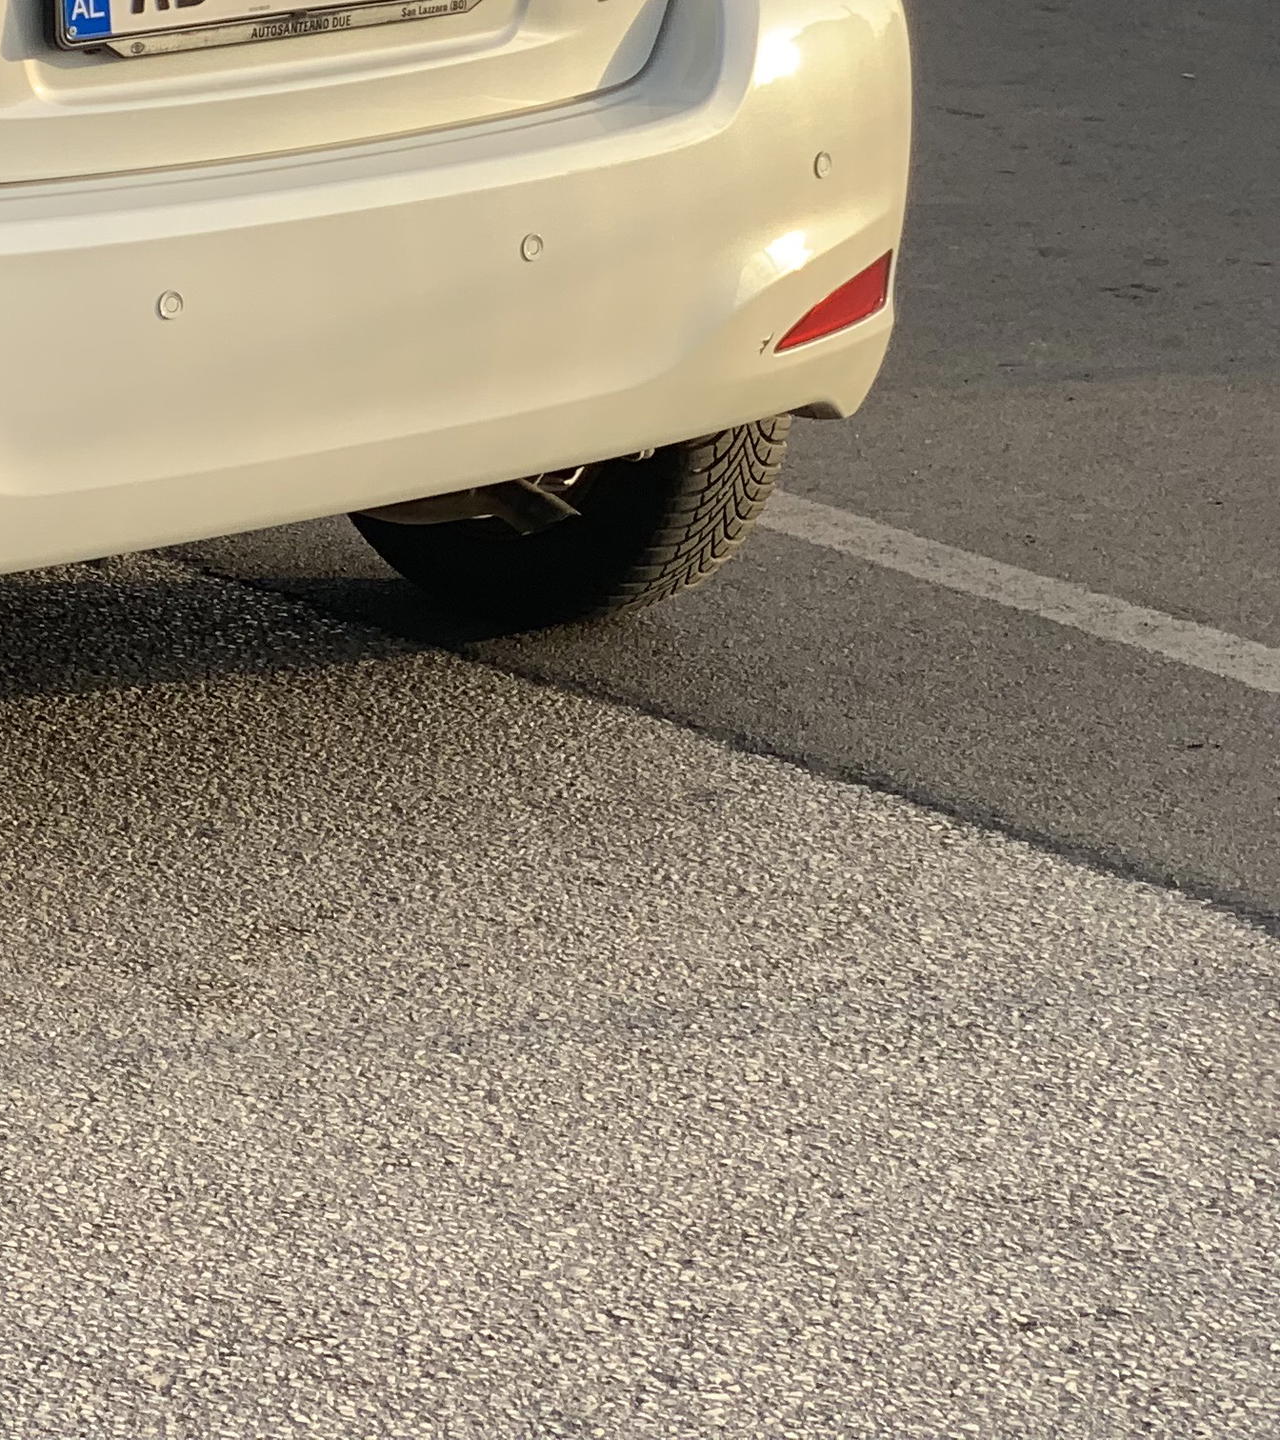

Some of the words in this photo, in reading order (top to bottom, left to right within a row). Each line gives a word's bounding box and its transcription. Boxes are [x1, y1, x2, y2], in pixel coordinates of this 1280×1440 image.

[401, 6, 416, 18] San
[251, 18, 329, 39] AUTOSANTERNO
[332, 14, 352, 29] DUE
